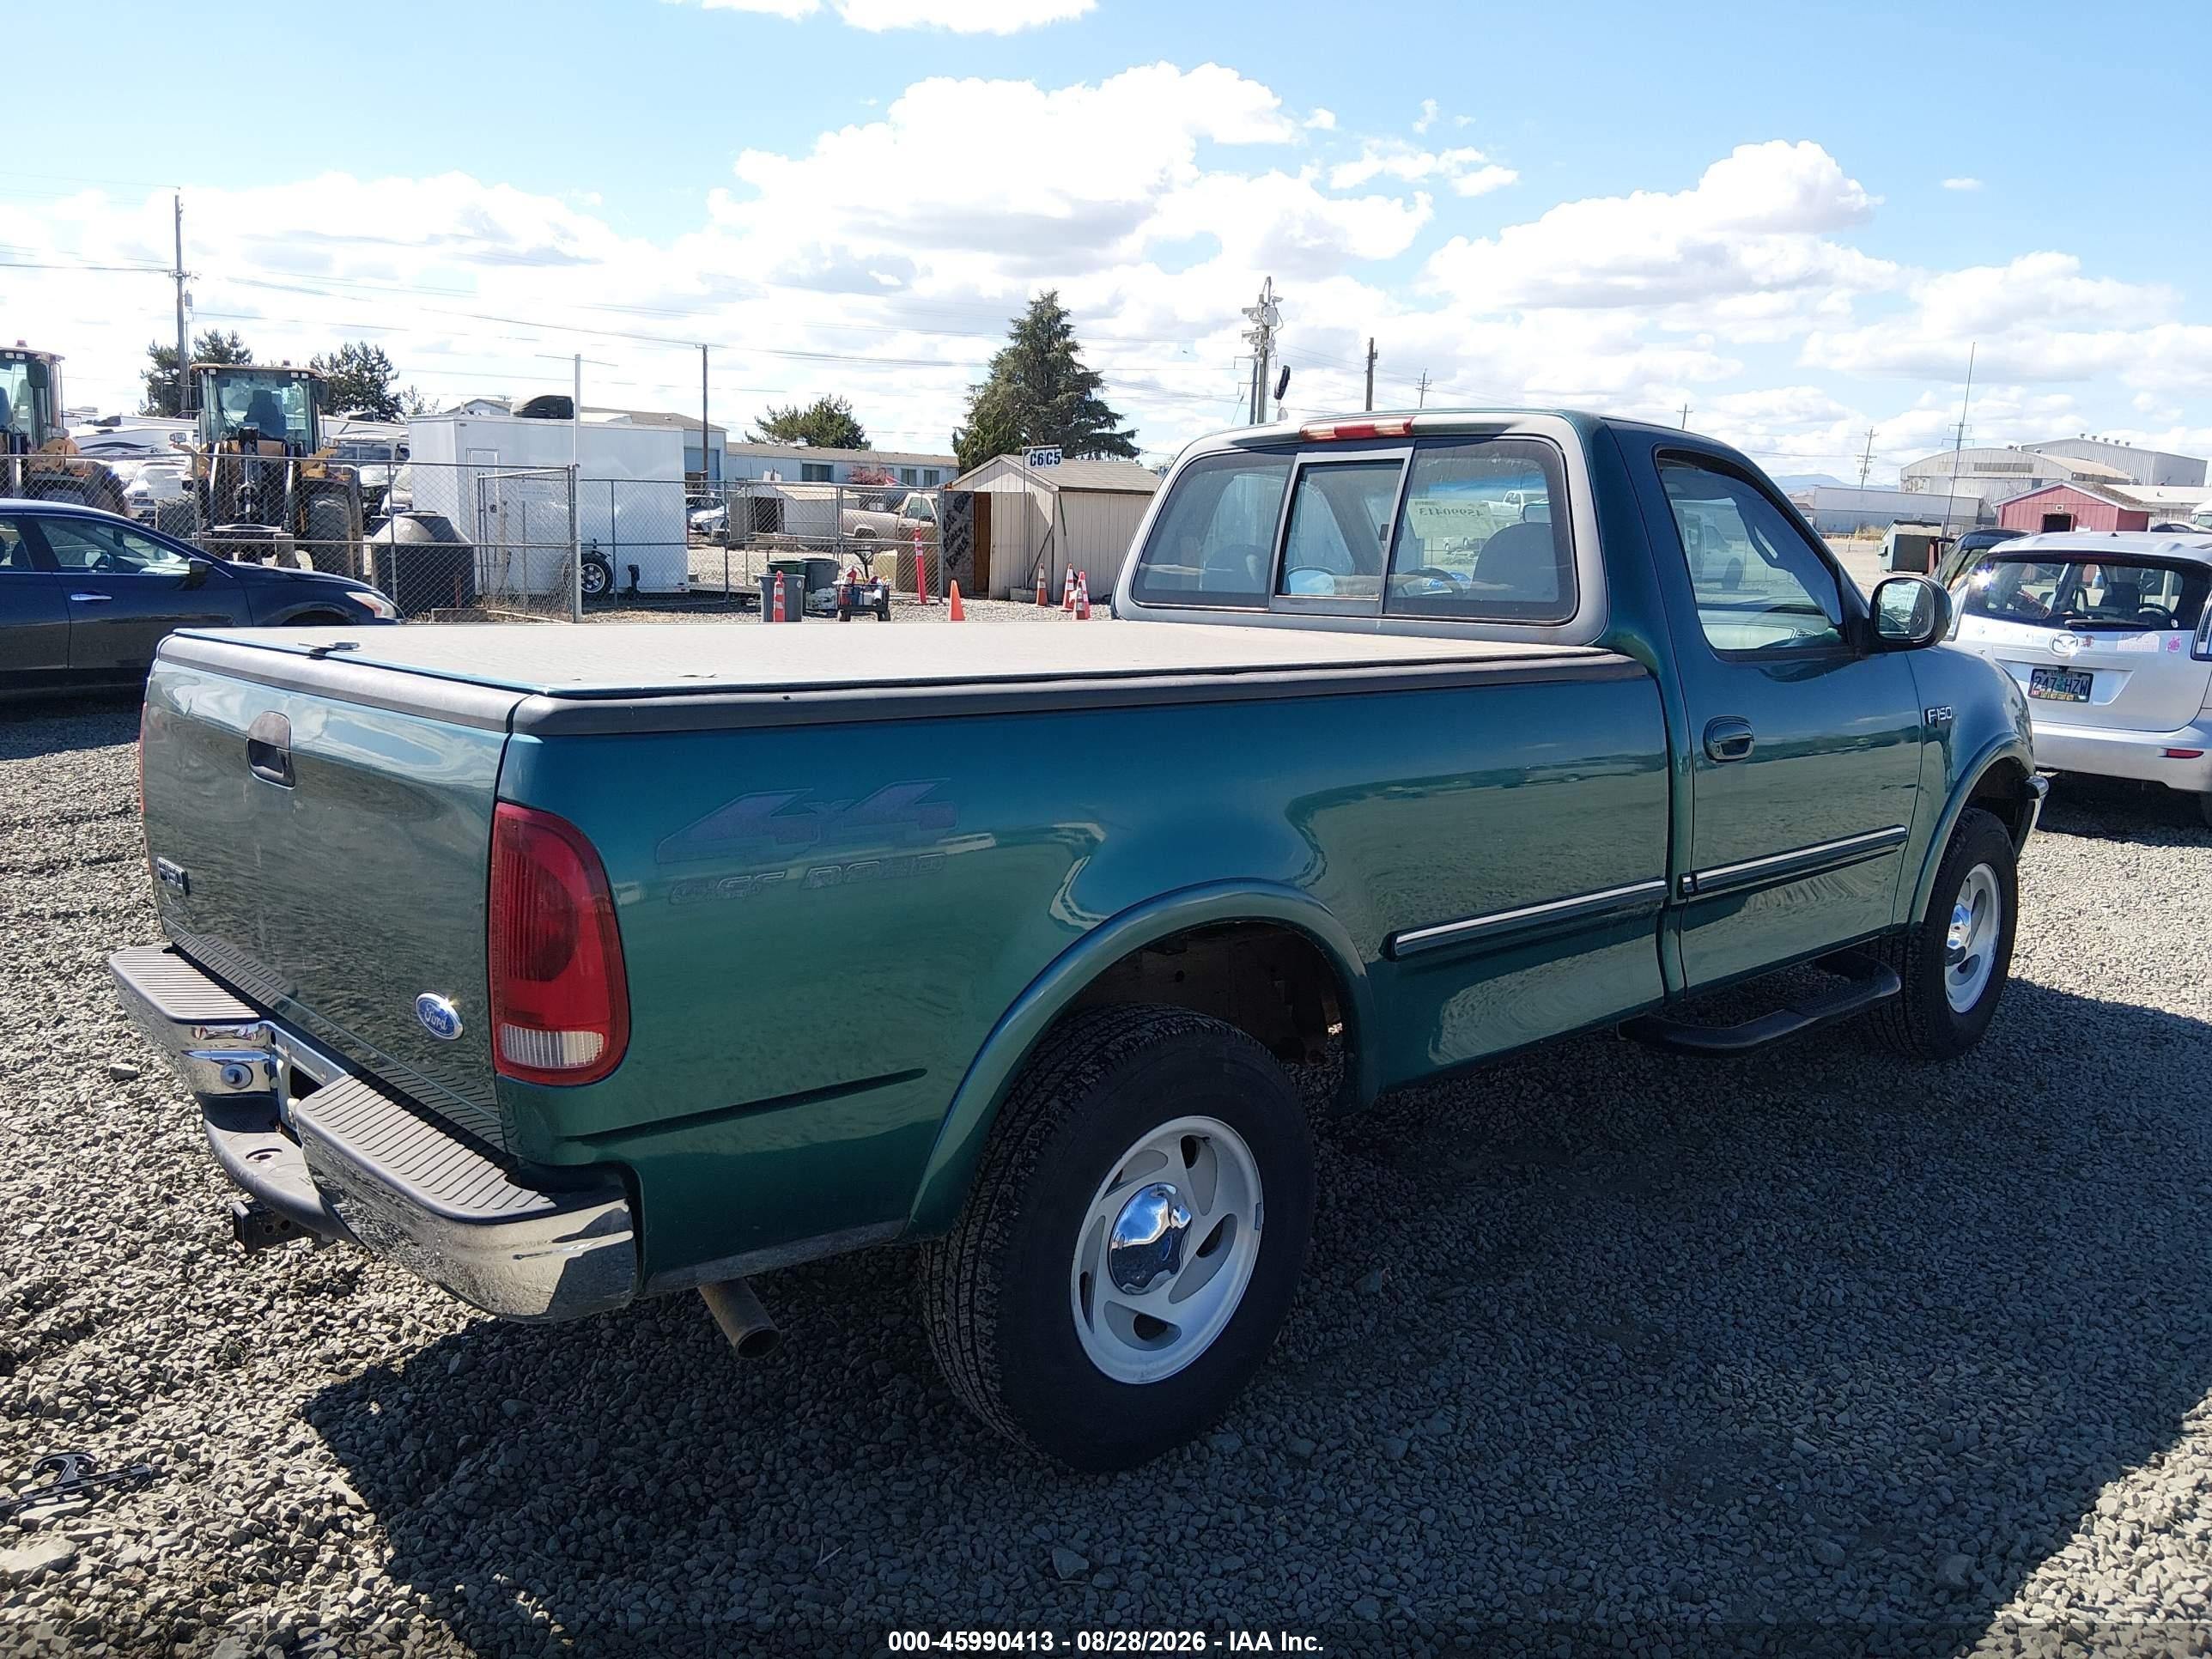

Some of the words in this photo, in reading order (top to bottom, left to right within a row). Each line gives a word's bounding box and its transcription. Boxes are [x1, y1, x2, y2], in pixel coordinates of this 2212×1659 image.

[1030, 452, 1045, 467] C6
[1045, 451, 1061, 465] C5
[2033, 675, 2058, 692] 247
[2063, 678, 2089, 695] HZW
[424, 1001, 449, 1031] Ford
